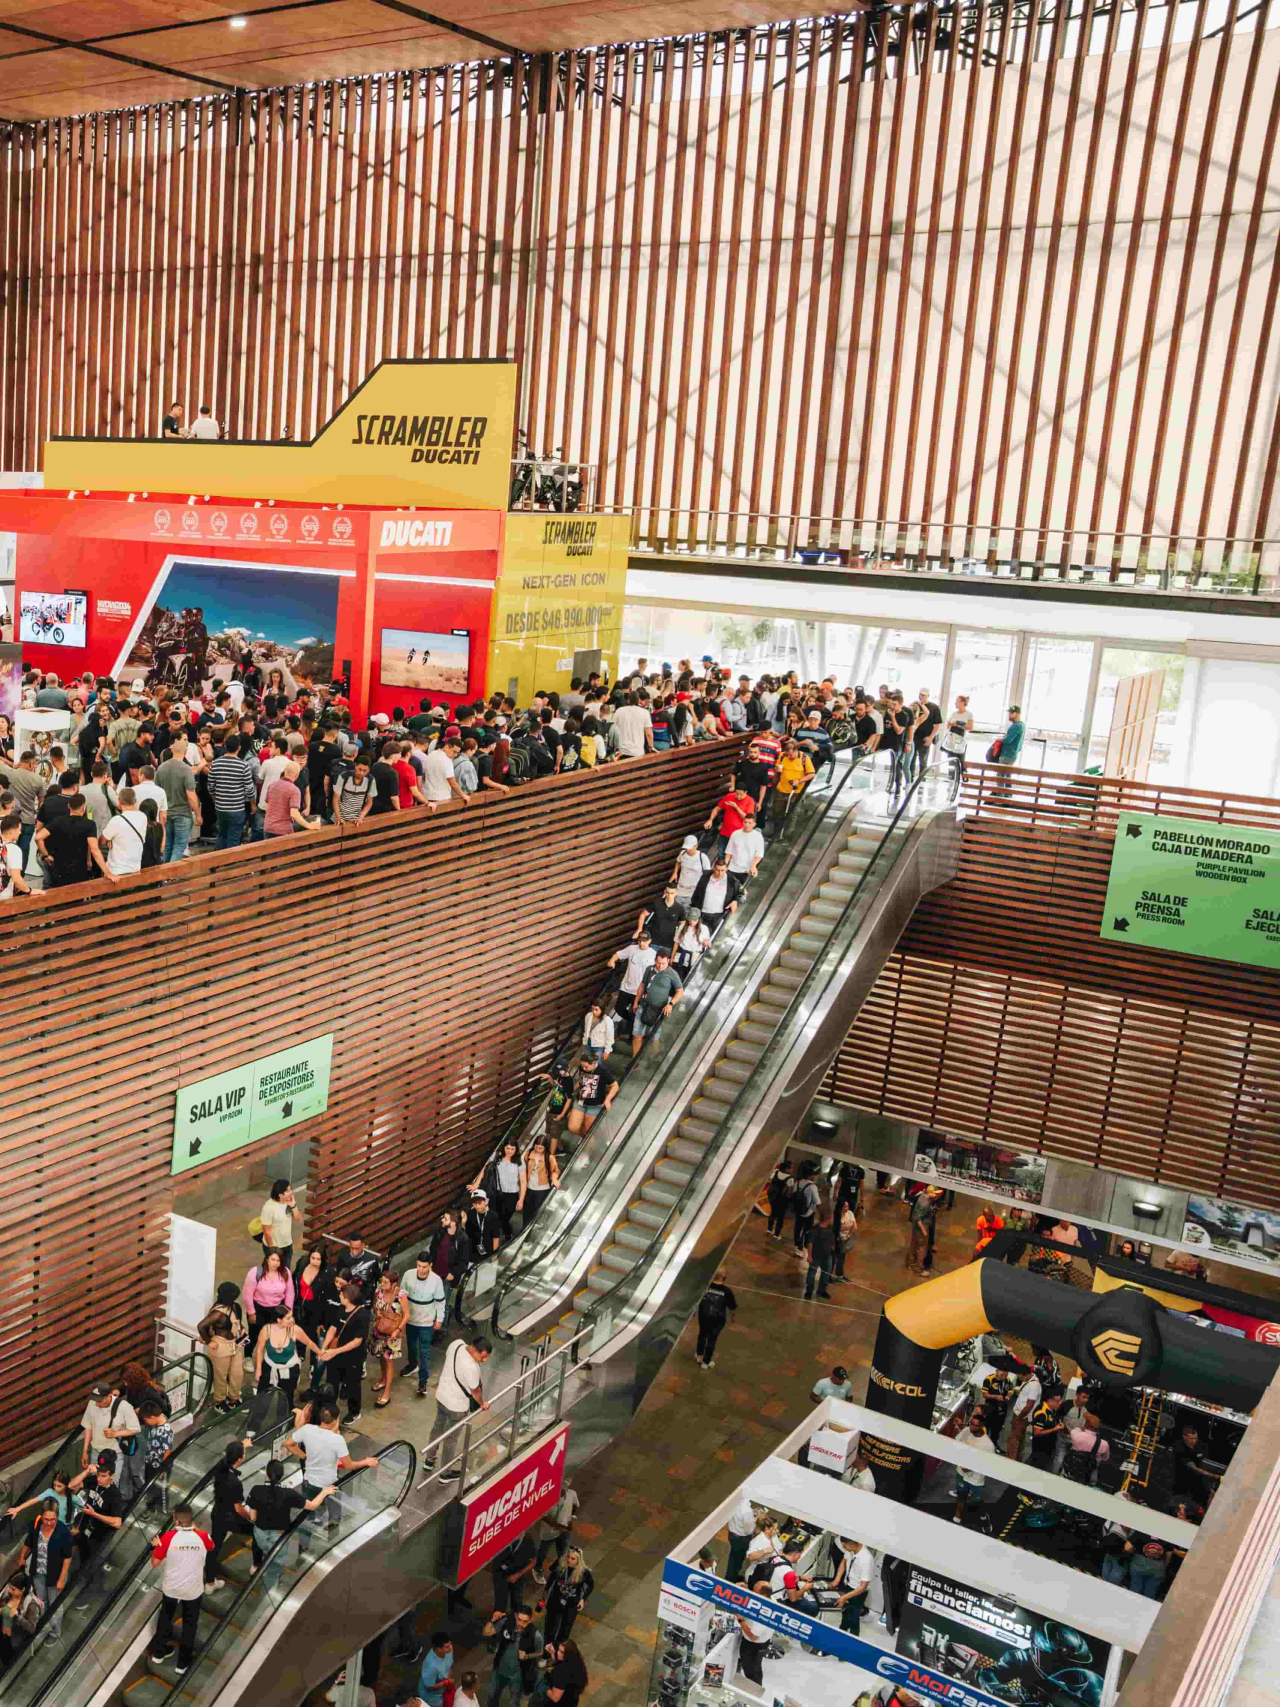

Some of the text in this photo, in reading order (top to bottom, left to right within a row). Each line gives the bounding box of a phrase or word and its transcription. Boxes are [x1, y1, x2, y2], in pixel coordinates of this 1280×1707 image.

[352, 415, 488, 448] SCRAMBLER
[411, 447, 481, 466] DUCATI
[380, 520, 453, 547] DUCATI
[542, 521, 597, 545] SCRAMBLER
[566, 545, 593, 557] DUCATI
[522, 572, 607, 590] NEXT-GEN ICON
[505, 610, 539, 634] DESDE
[1152, 841, 1254, 865] CAJA DE MADERA
[1153, 829, 1271, 855] PABELLÓN MORADO
[1195, 870, 1248, 884] WOODEN BOX
[1196, 861, 1266, 878] PURPLE PAVILION
[1135, 901, 1181, 918] PRENSA
[1141, 890, 1189, 908] SALA DE
[1136, 912, 1185, 926] PRESS ROOM
[259, 1070, 315, 1101] DE EXPOSITORES
[260, 1060, 309, 1088] RESTAURANTE
[290, 1081, 315, 1098] RESTAURANT
[189, 1086, 246, 1124] SALA VIP
[220, 1108, 243, 1123] VIP ROOM
[471, 1467, 539, 1540] DUCATI
[468, 1478, 556, 1557] SUBE DE NIVEL
[911, 1570, 942, 1589] Equipa
[943, 1583, 953, 1593] tu
[955, 1588, 980, 1605] taller,
[673, 1602, 697, 1617] BOSCH
[713, 1584, 813, 1635] MolPartes
[909, 1578, 1032, 1639] financiamos!
